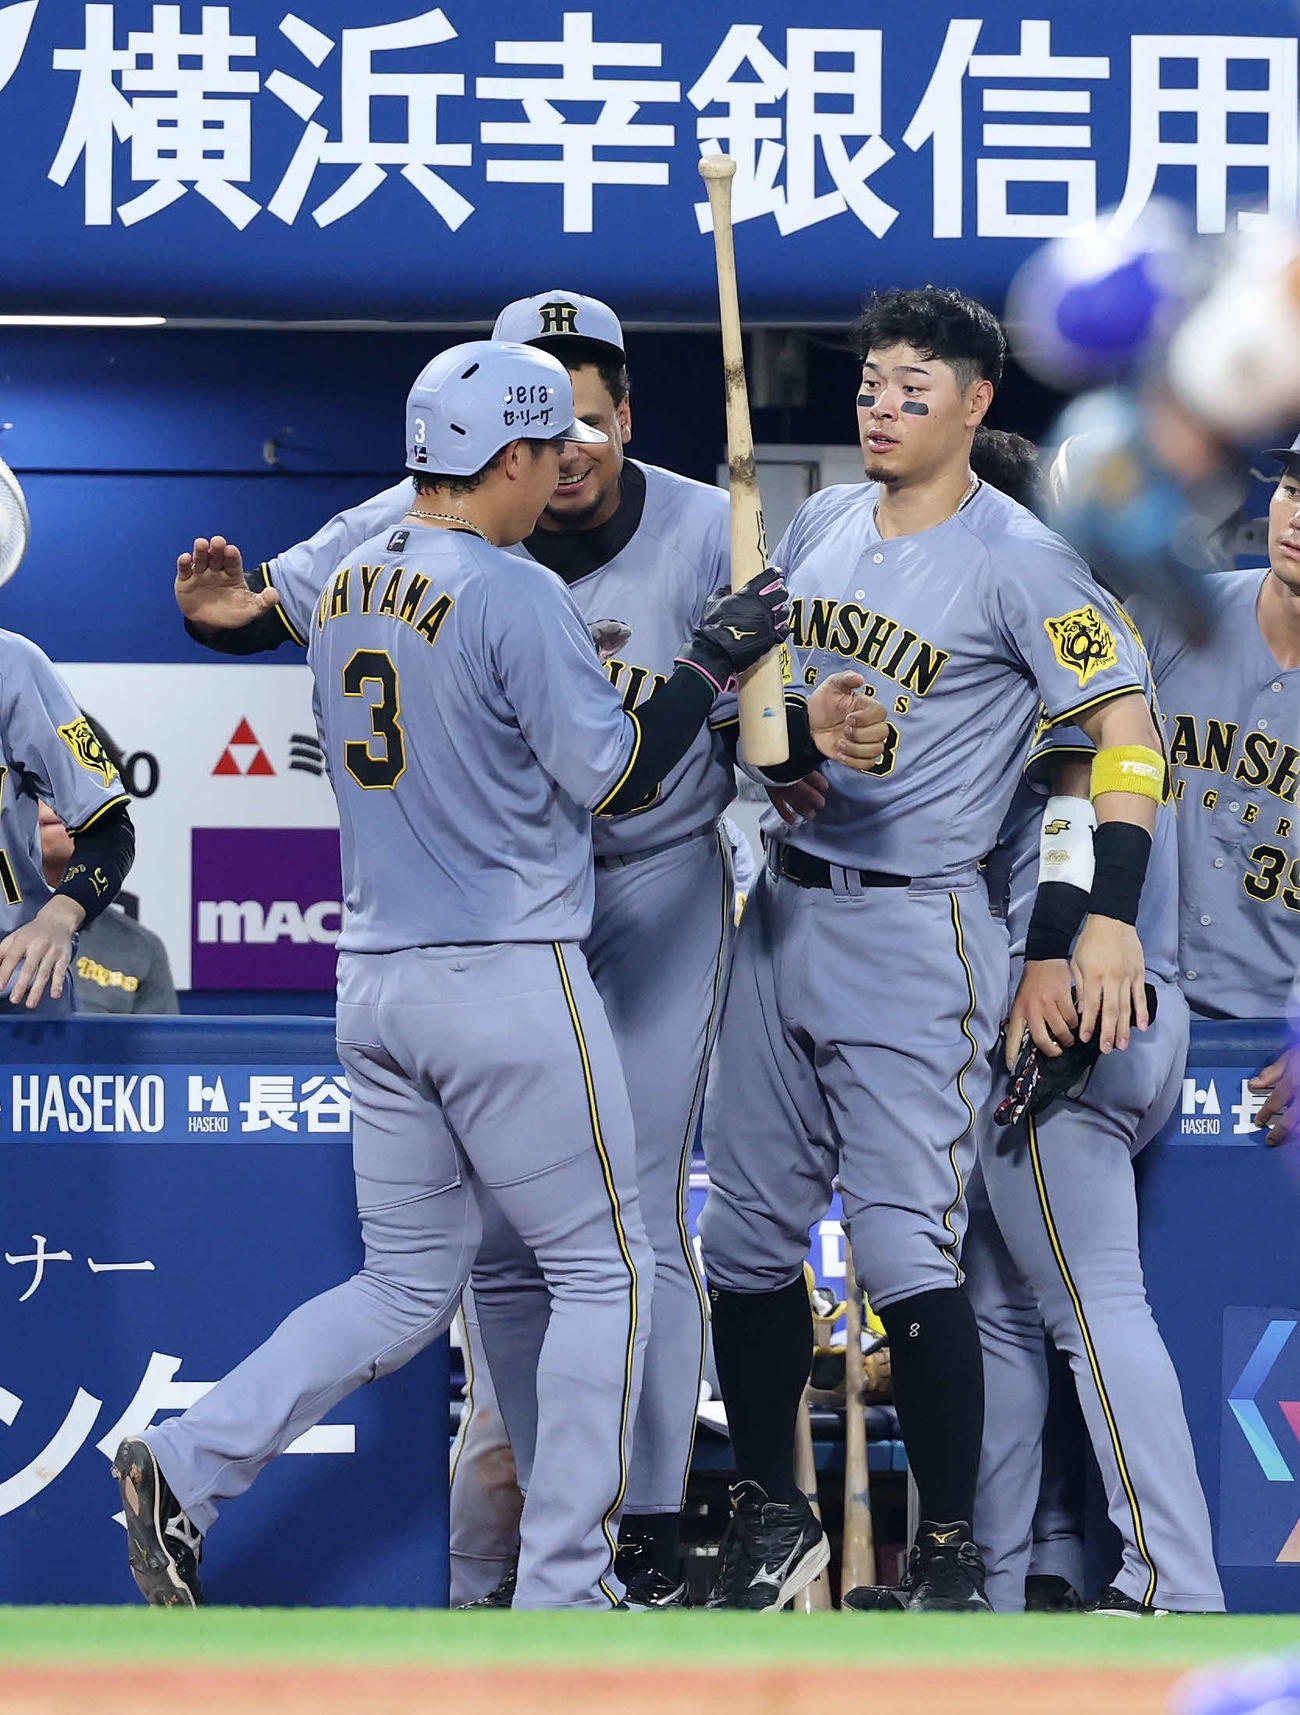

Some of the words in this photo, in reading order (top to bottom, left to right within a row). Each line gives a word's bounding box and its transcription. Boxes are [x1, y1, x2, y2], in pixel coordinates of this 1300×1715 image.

[48, 3, 1299, 240] 横浜幸銀信用
[414, 417, 426, 444] 3
[341, 648, 408, 790] 3
[12, 1074, 165, 1133] HASEKO
[187, 1116, 229, 1133] HASEKO
[239, 1075, 351, 1133] 長谷
[1181, 1119, 1221, 1135] HASEKO
[5, 1234, 155, 1302] ナー
[909, 1322, 921, 1338] 8
